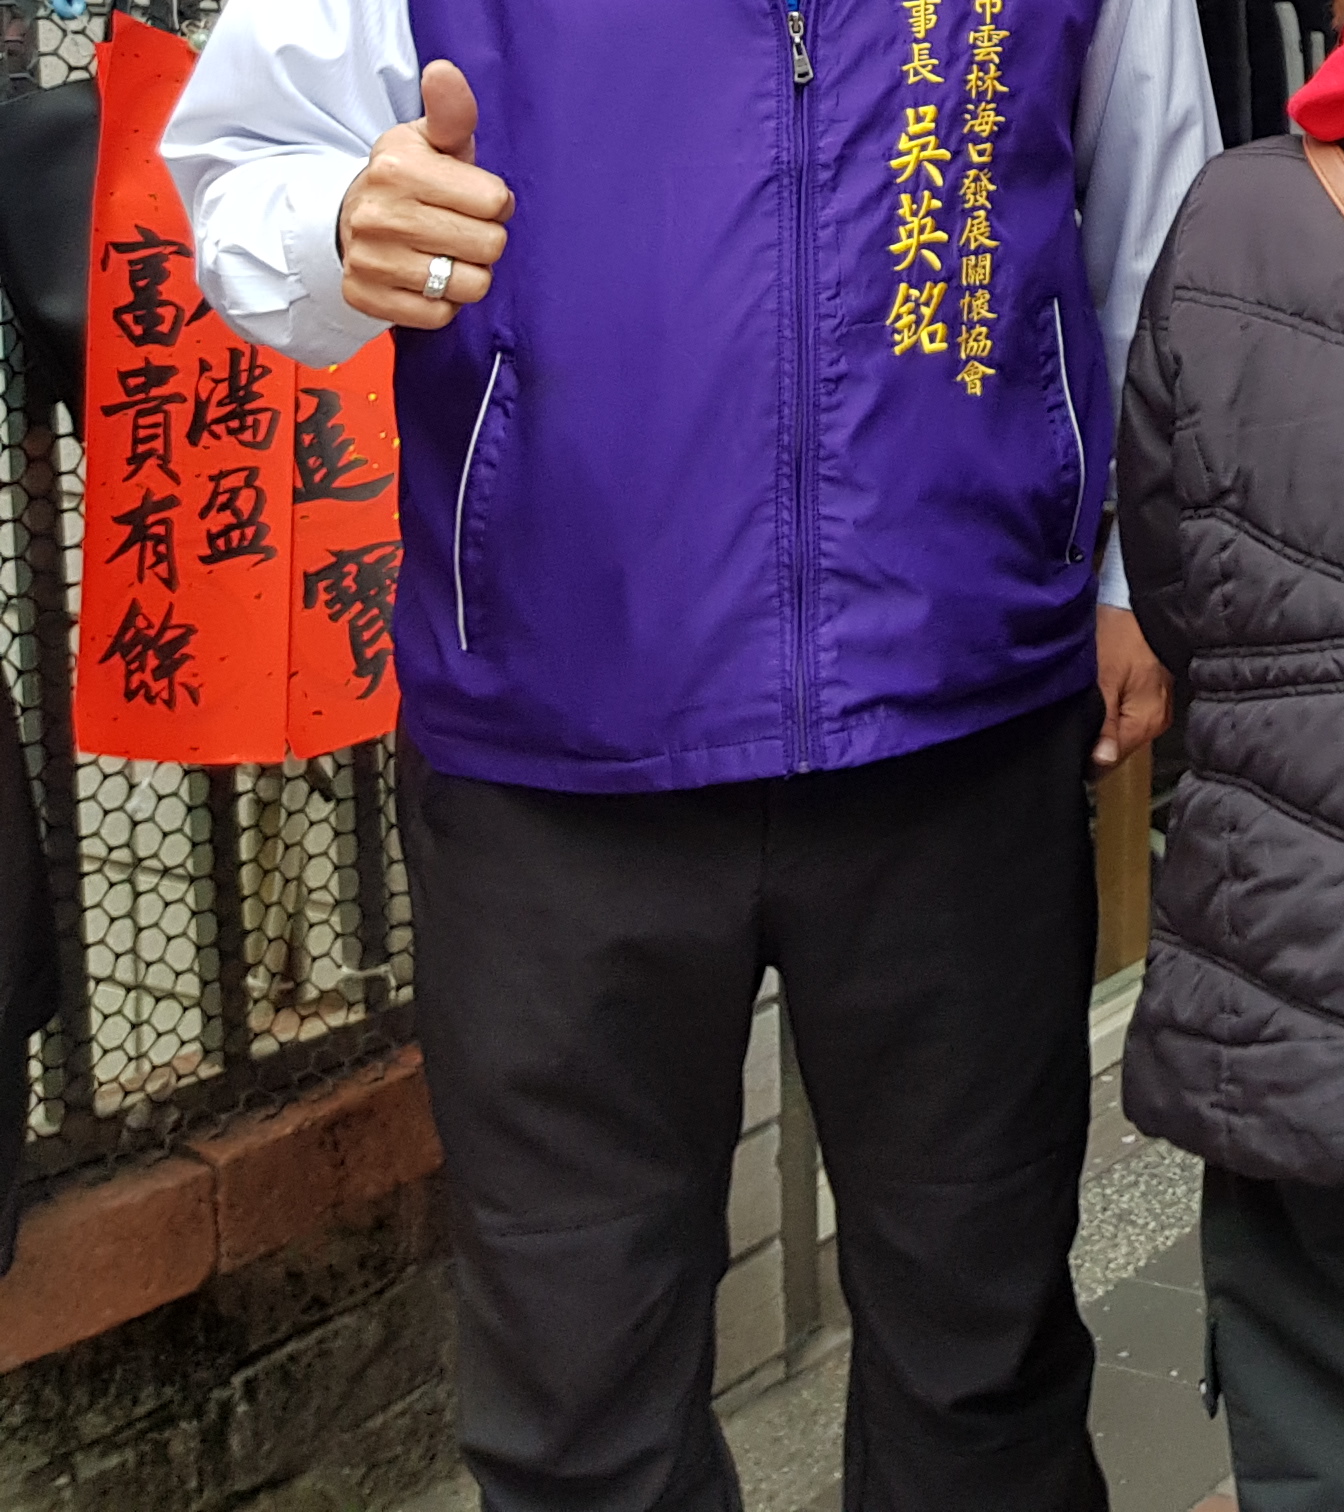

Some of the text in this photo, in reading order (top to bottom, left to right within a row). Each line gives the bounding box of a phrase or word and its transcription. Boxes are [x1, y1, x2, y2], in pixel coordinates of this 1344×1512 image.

[886, 104, 952, 356] 吳英銘
[101, 224, 202, 711] 富貴有餘
[185, 297, 281, 568] 滿盈
